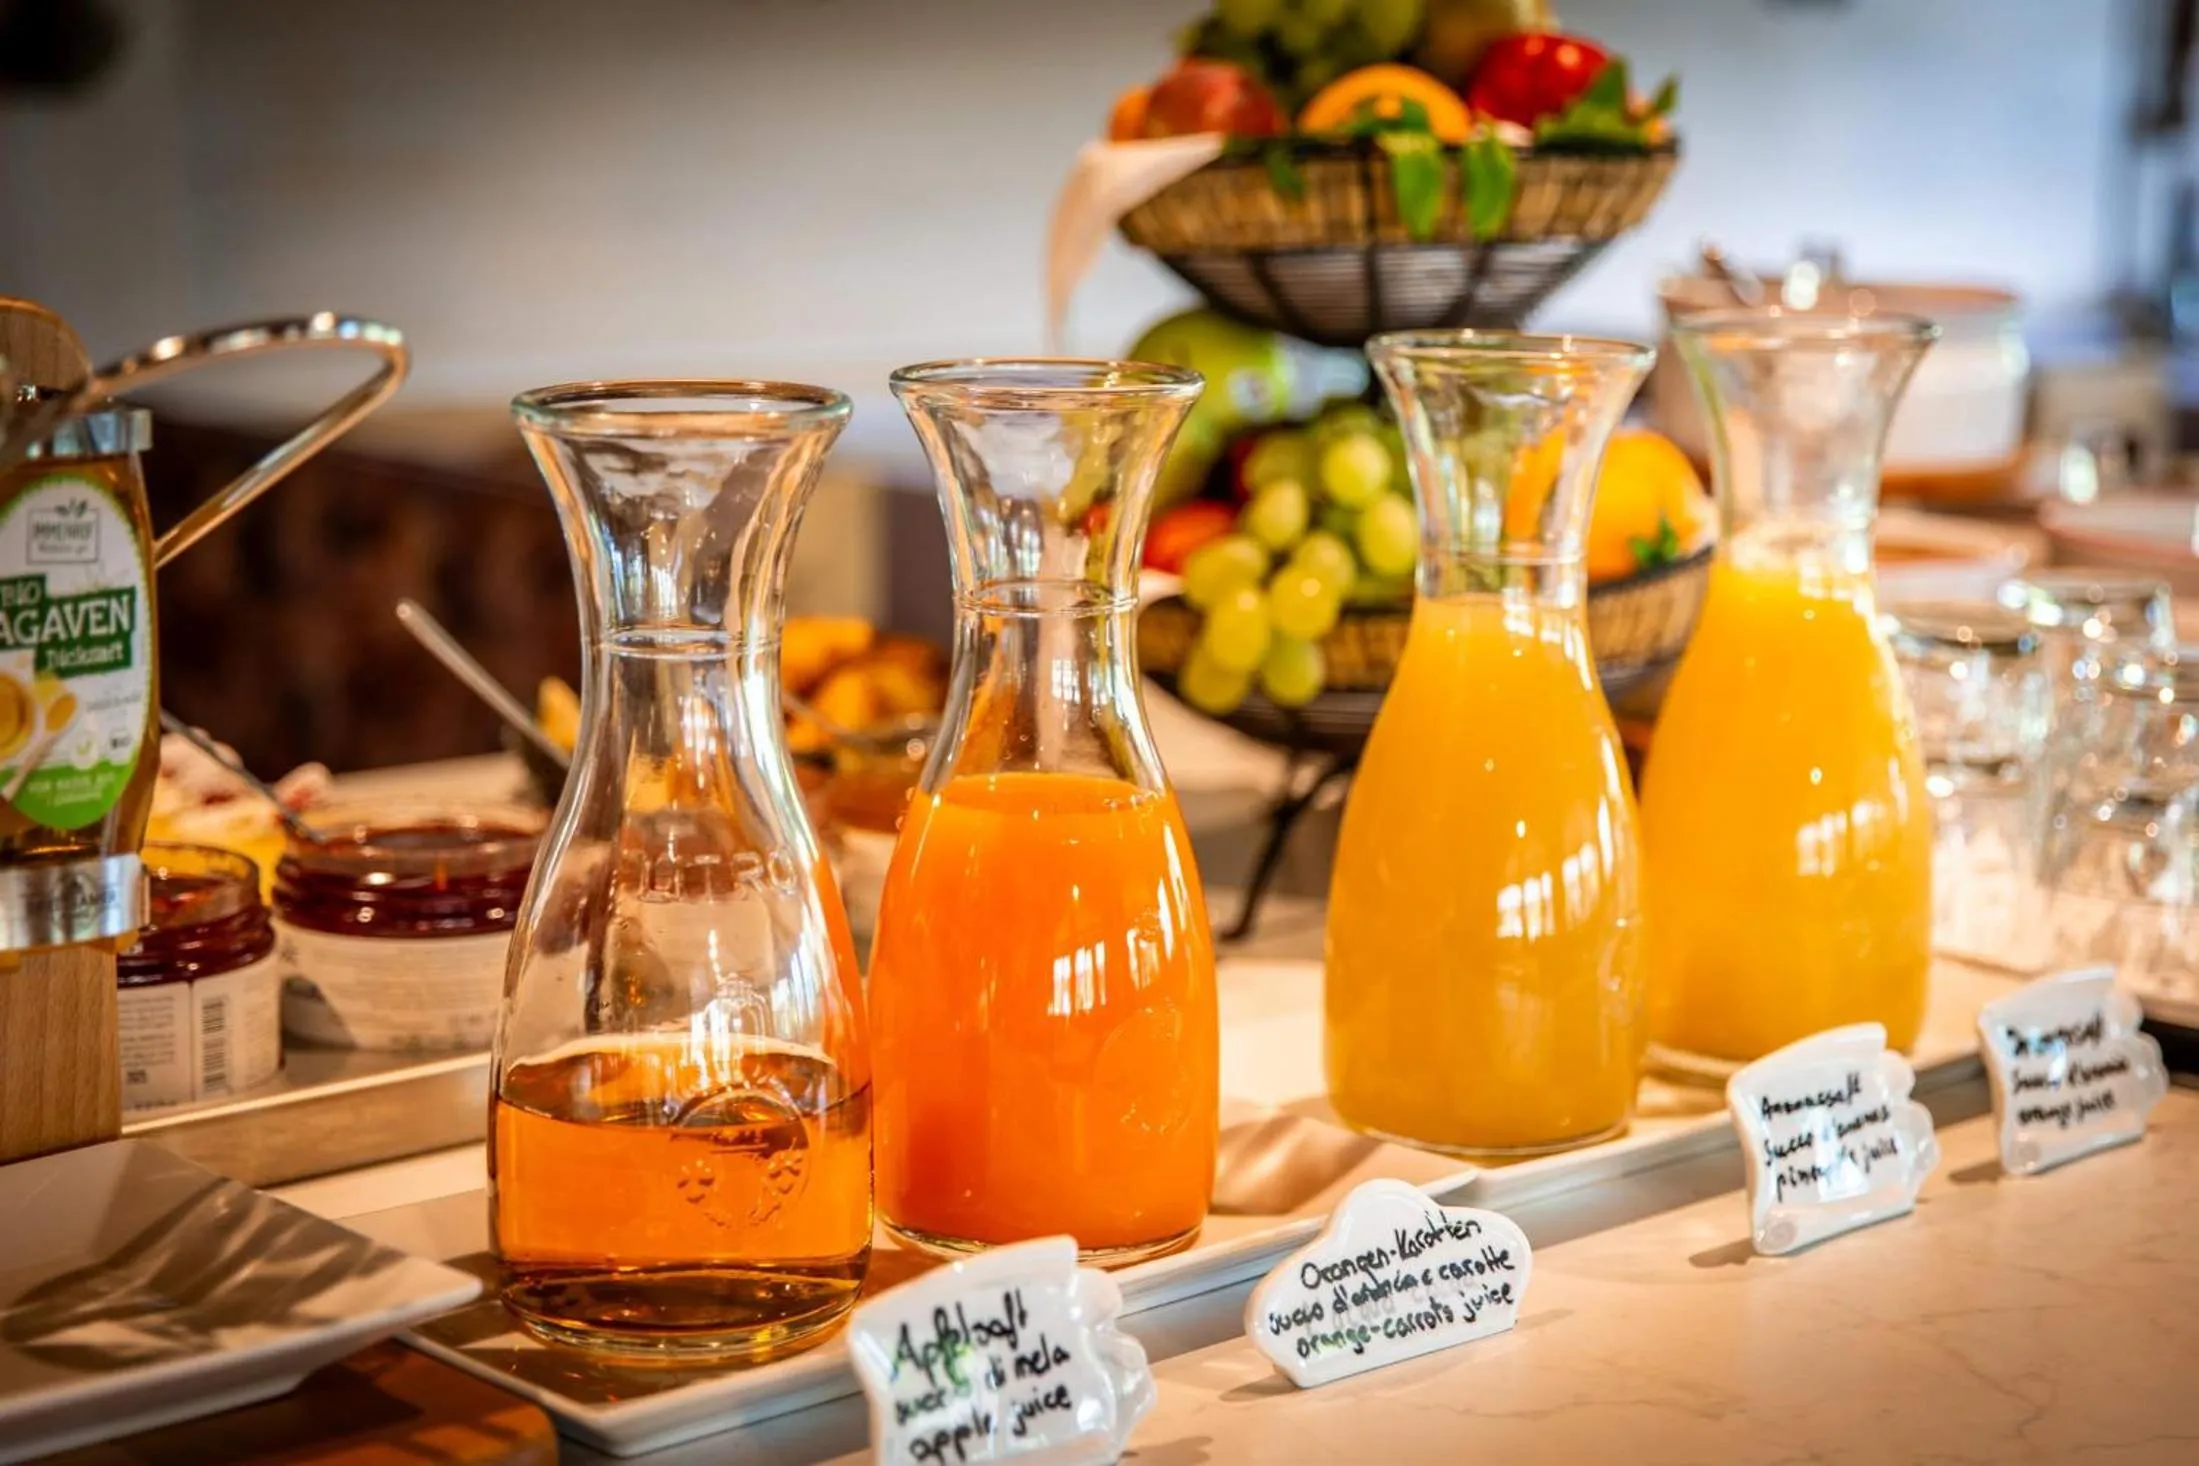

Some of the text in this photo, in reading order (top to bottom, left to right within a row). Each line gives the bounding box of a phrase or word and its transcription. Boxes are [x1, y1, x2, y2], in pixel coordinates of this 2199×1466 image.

[1, 580, 42, 606] BIO
[0, 595, 131, 646] AGAVEN
[1011, 1383, 1072, 1438] juice
